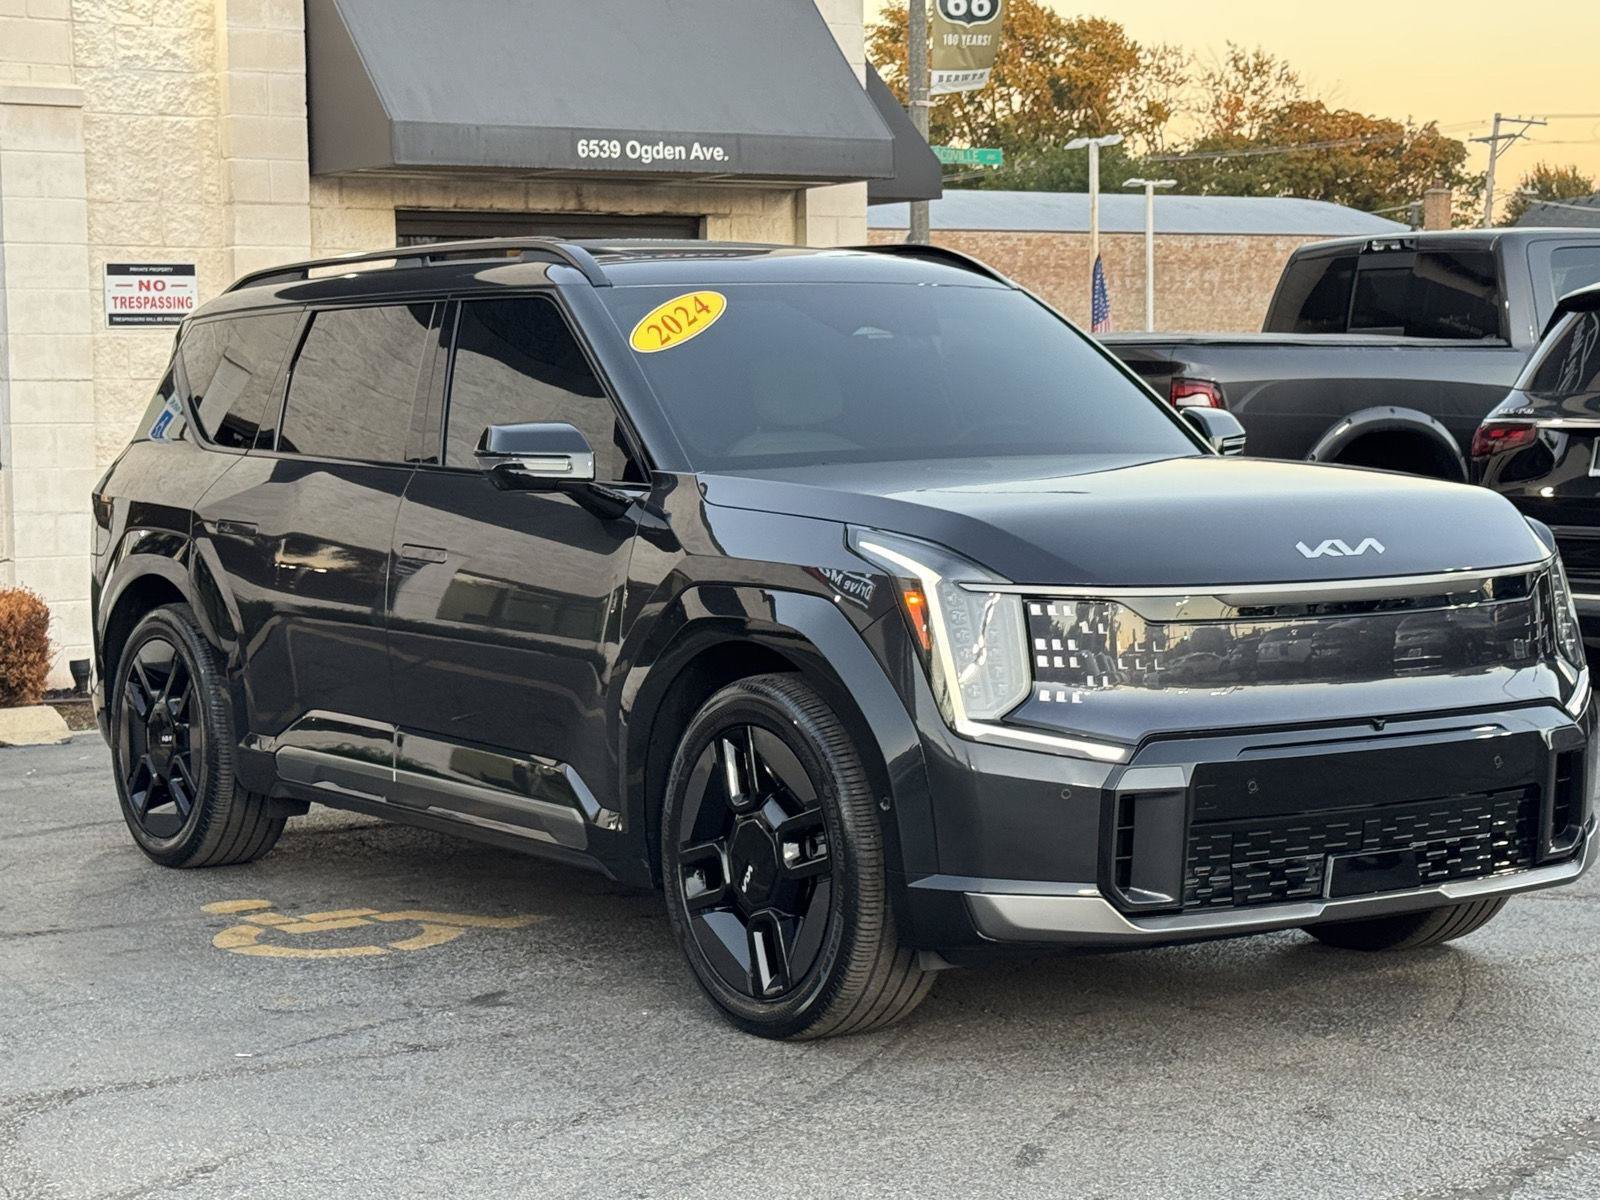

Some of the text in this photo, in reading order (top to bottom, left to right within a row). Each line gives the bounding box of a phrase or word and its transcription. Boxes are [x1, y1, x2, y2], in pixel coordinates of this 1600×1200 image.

[947, 0, 992, 17] 66
[961, 34, 992, 47] YEARS!
[577, 139, 730, 164] 6539 Ogden Ave.
[138, 279, 166, 292] NO
[112, 296, 193, 310] TRESPASSING
[646, 296, 711, 345] 2024
